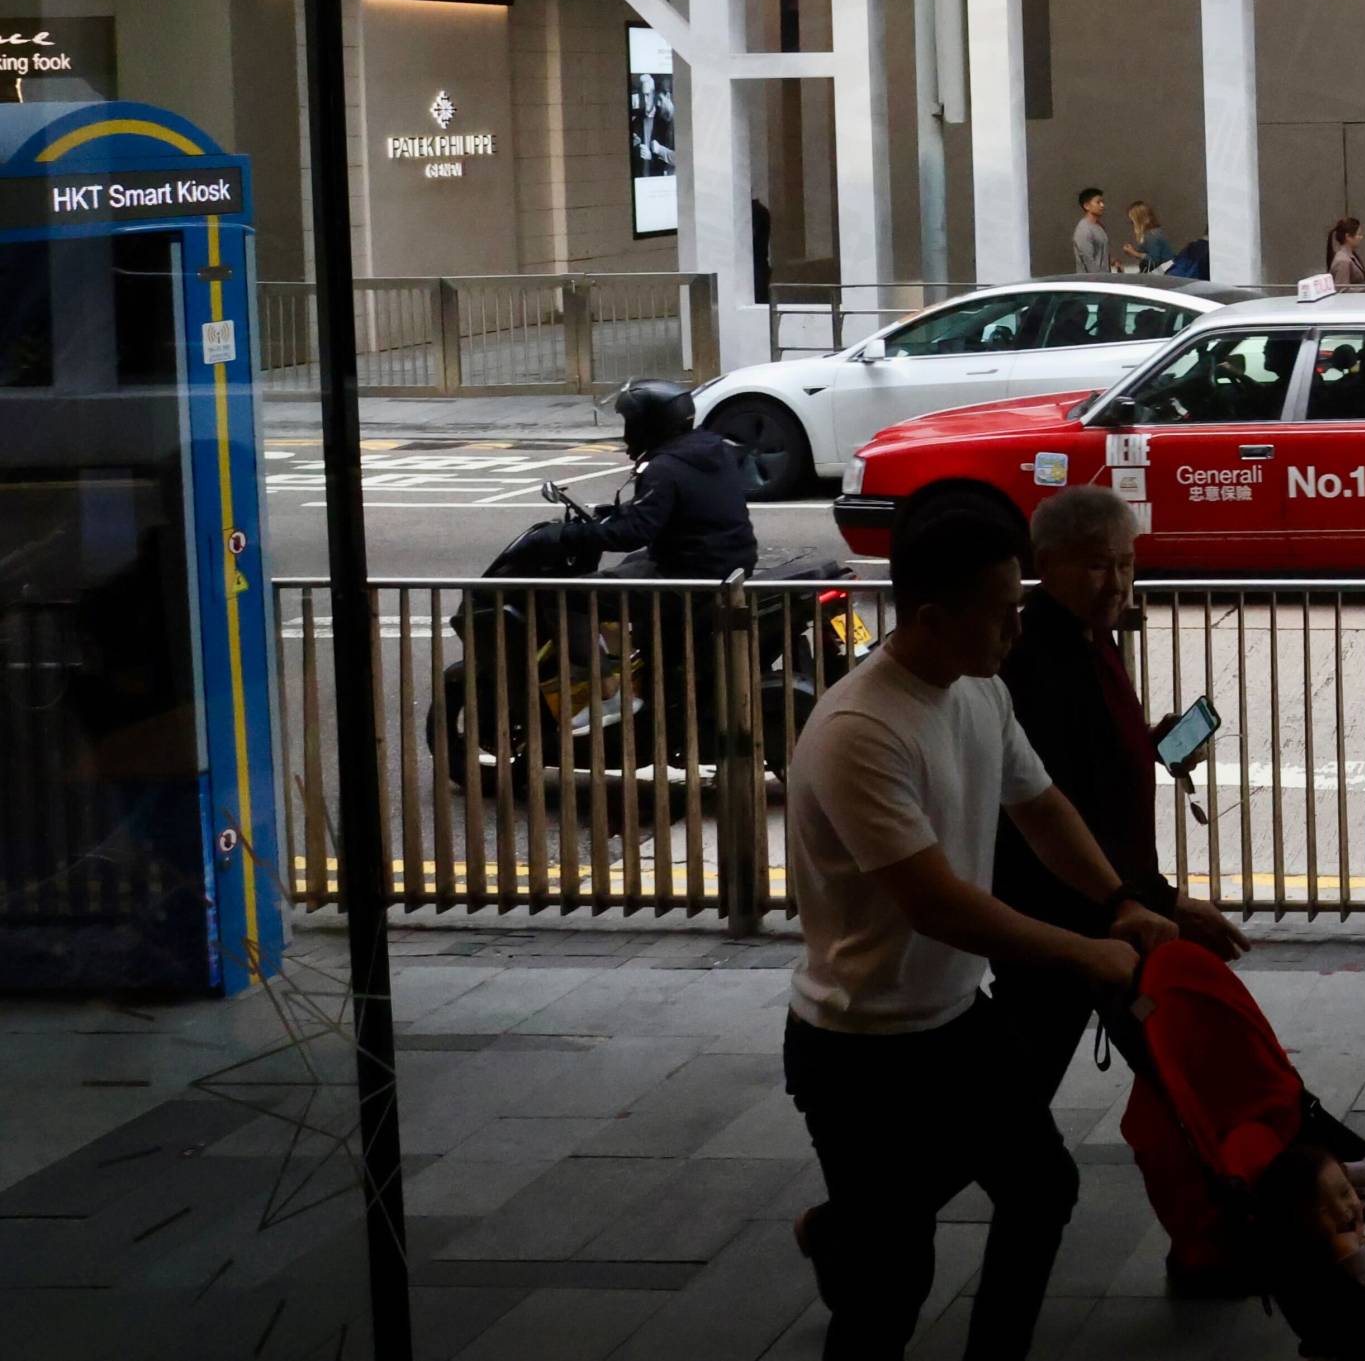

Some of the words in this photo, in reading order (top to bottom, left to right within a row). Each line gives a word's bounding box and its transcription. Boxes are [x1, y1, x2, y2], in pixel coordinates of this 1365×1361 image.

[0, 31, 57, 46] ce
[0, 53, 28, 75] ing
[32, 52, 72, 71] fook
[387, 136, 434, 159] PATEK
[435, 134, 498, 157] PHILIPPE
[53, 184, 103, 213] HKT
[109, 182, 172, 208] Smart
[178, 178, 232, 203] Kiosk
[1176, 465, 1263, 485] Generali
[1187, 486, 1254, 502] 忠意保險
